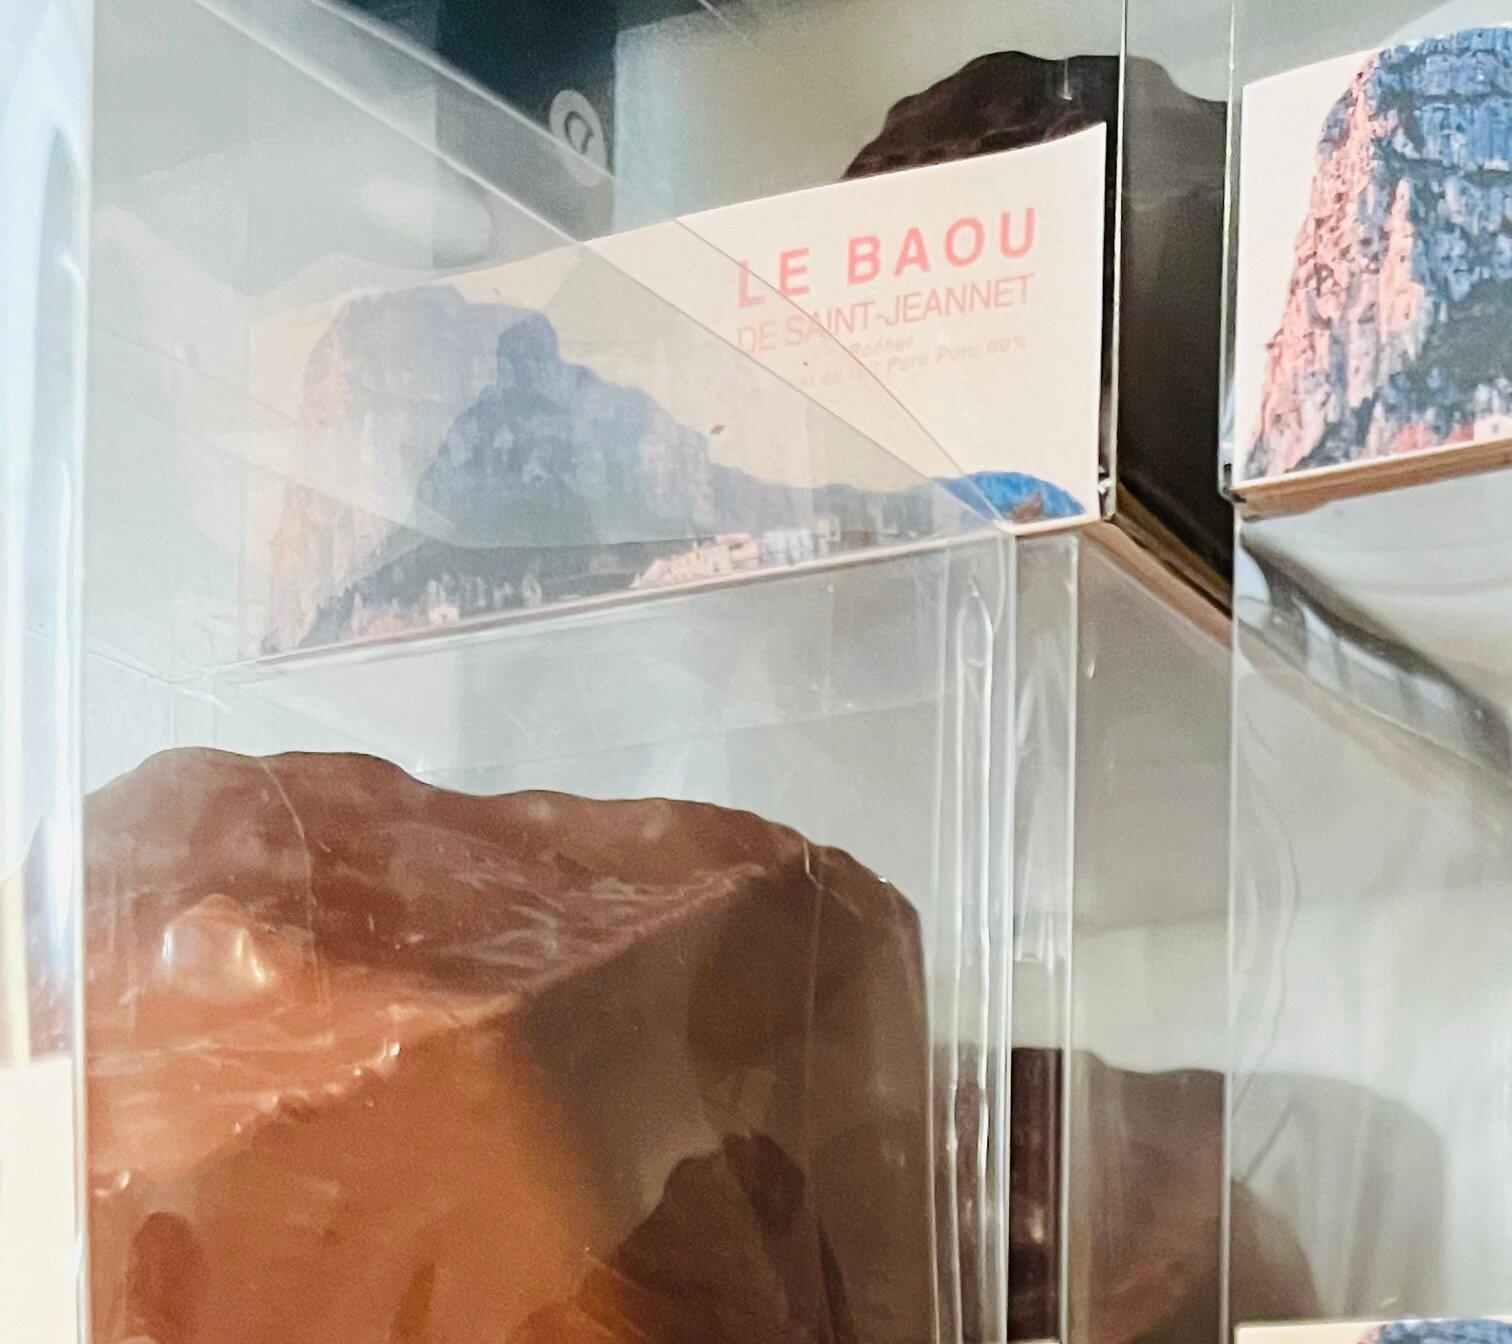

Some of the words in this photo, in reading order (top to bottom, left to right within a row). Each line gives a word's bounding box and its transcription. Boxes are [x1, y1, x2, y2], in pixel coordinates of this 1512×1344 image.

[737, 246, 812, 309] LE
[846, 206, 1037, 286] BAOU
[737, 319, 778, 356] DE
[784, 272, 1036, 347] SAINT-JEANNET
